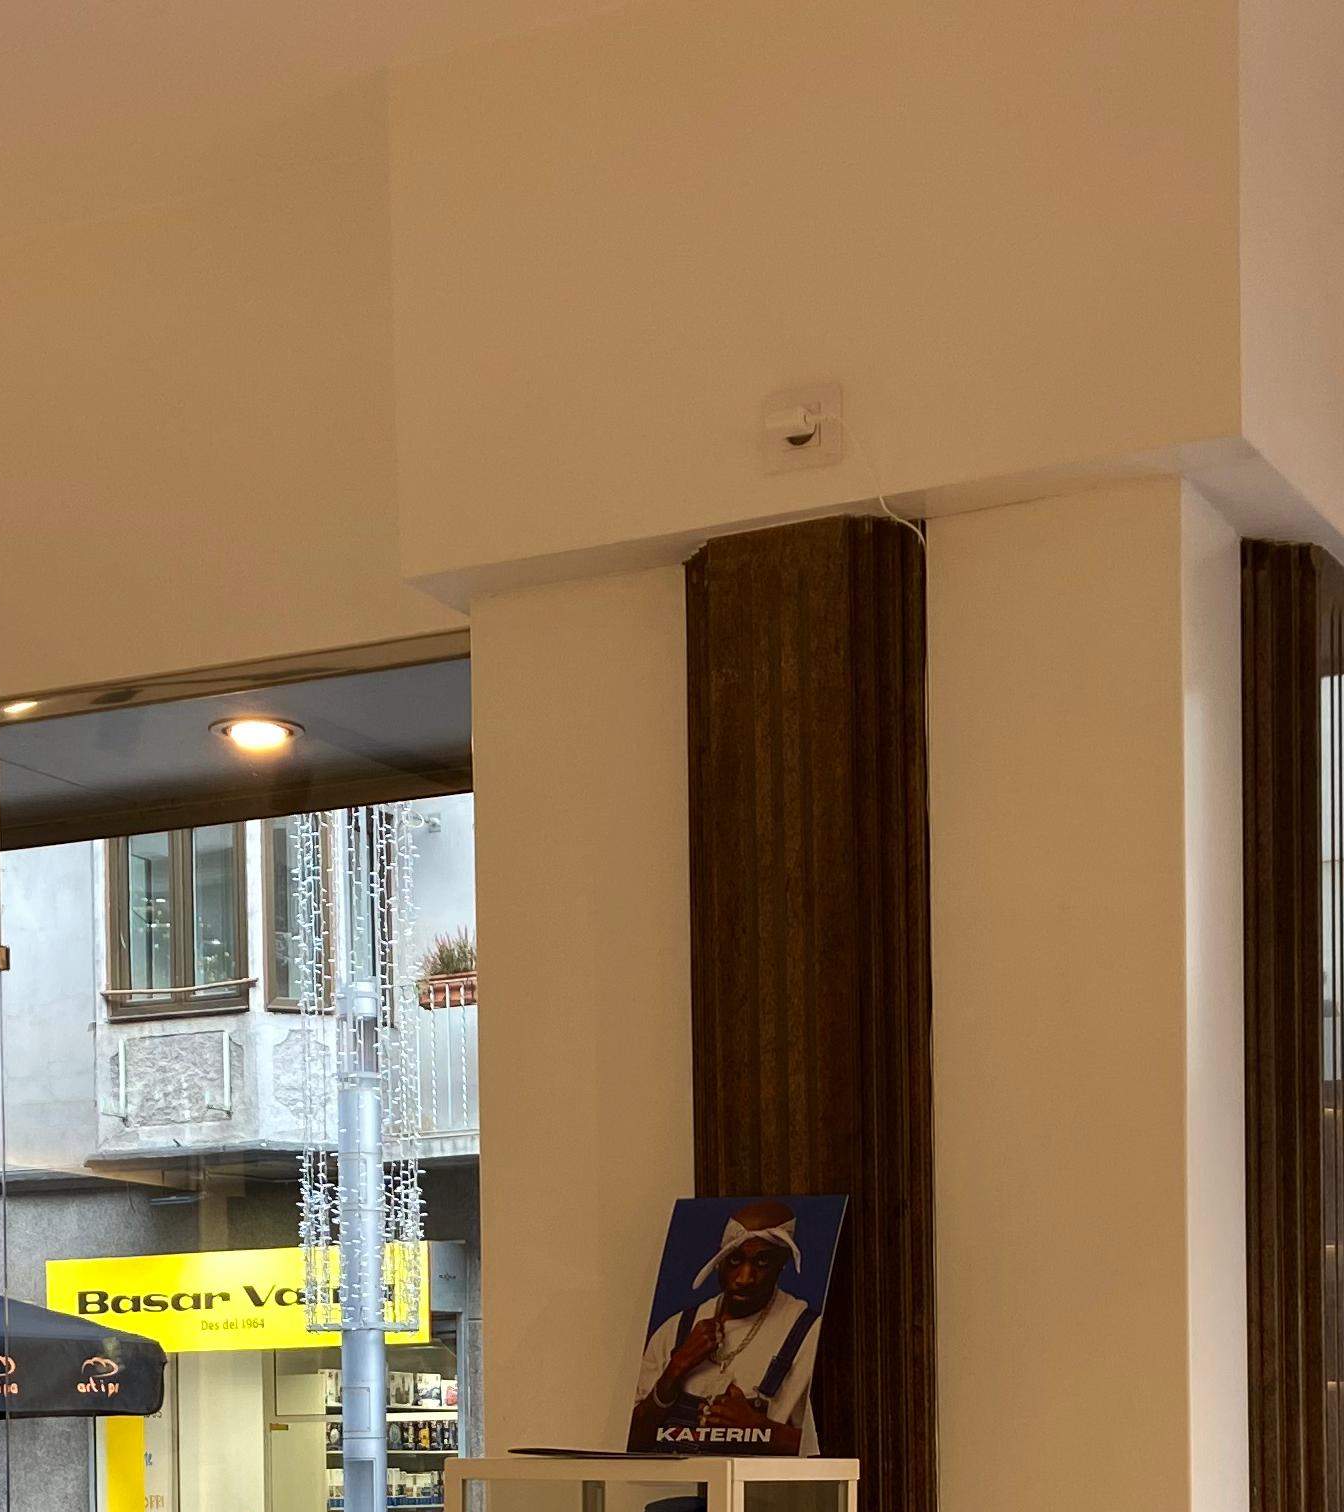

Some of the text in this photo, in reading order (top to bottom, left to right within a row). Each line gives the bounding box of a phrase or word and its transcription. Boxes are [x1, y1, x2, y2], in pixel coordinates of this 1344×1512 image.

[77, 1290, 231, 1316] Basar
[201, 1318, 265, 1331] Des del 1964
[656, 1427, 772, 1442] KATERIN
